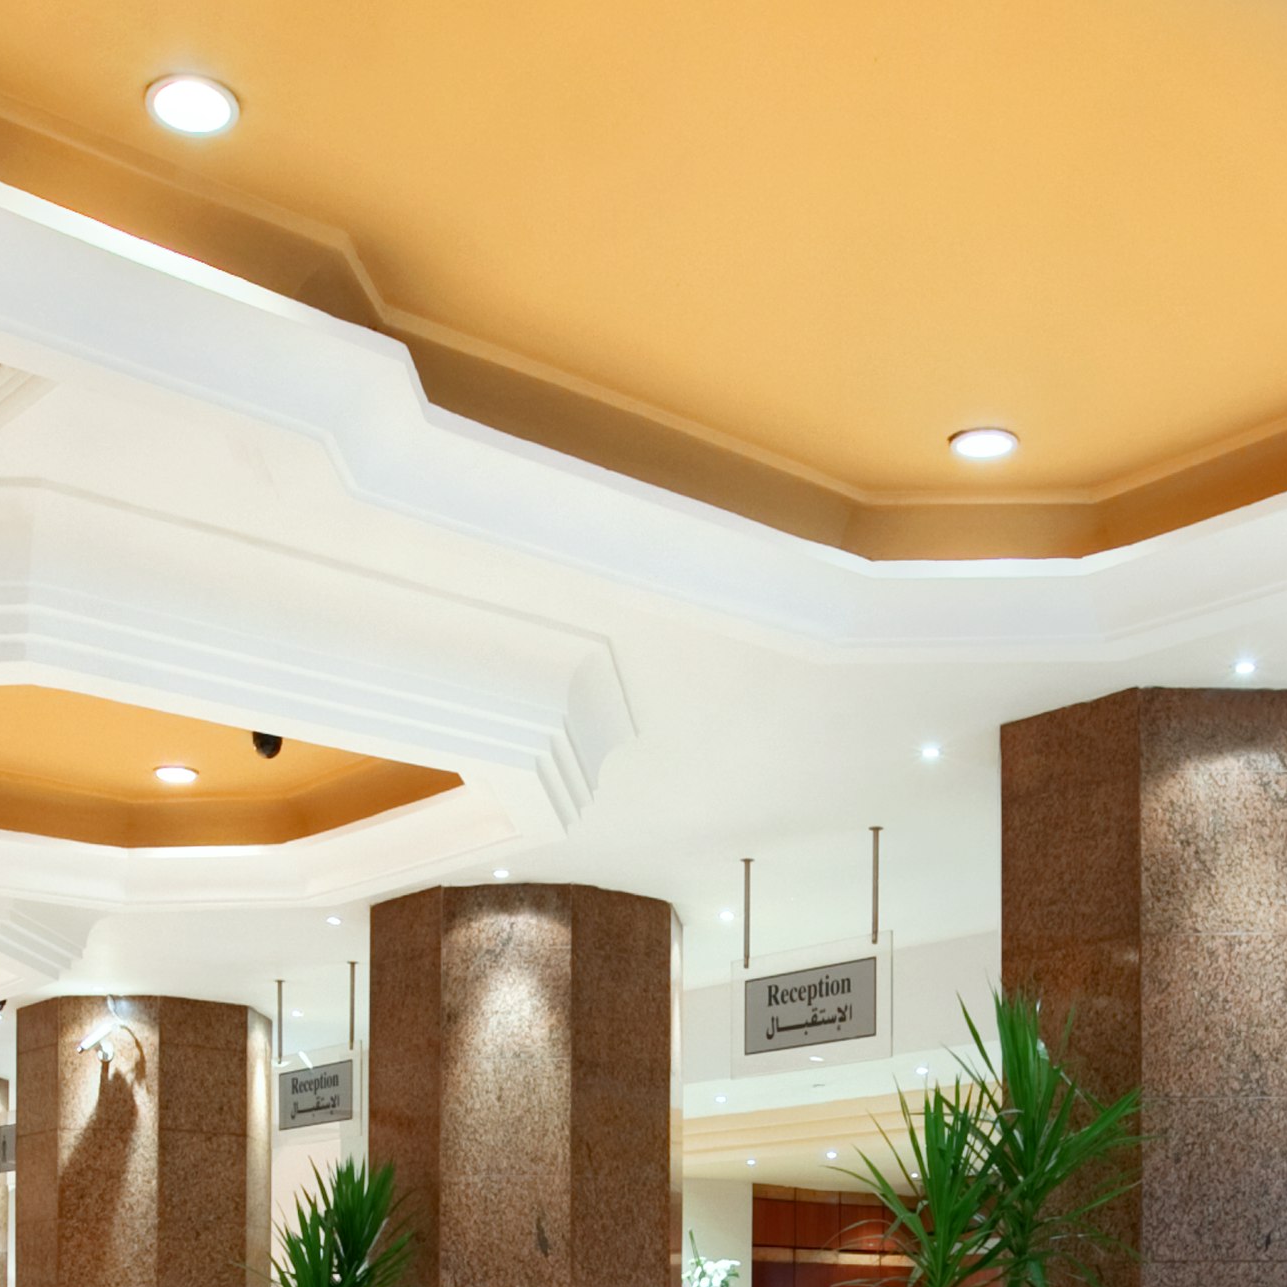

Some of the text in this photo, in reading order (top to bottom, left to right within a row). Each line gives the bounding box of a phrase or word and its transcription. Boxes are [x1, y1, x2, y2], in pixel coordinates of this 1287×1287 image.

[767, 974, 852, 1007] Reception
[766, 1003, 853, 1040] الإستقبال
[291, 1072, 340, 1095] Reception
